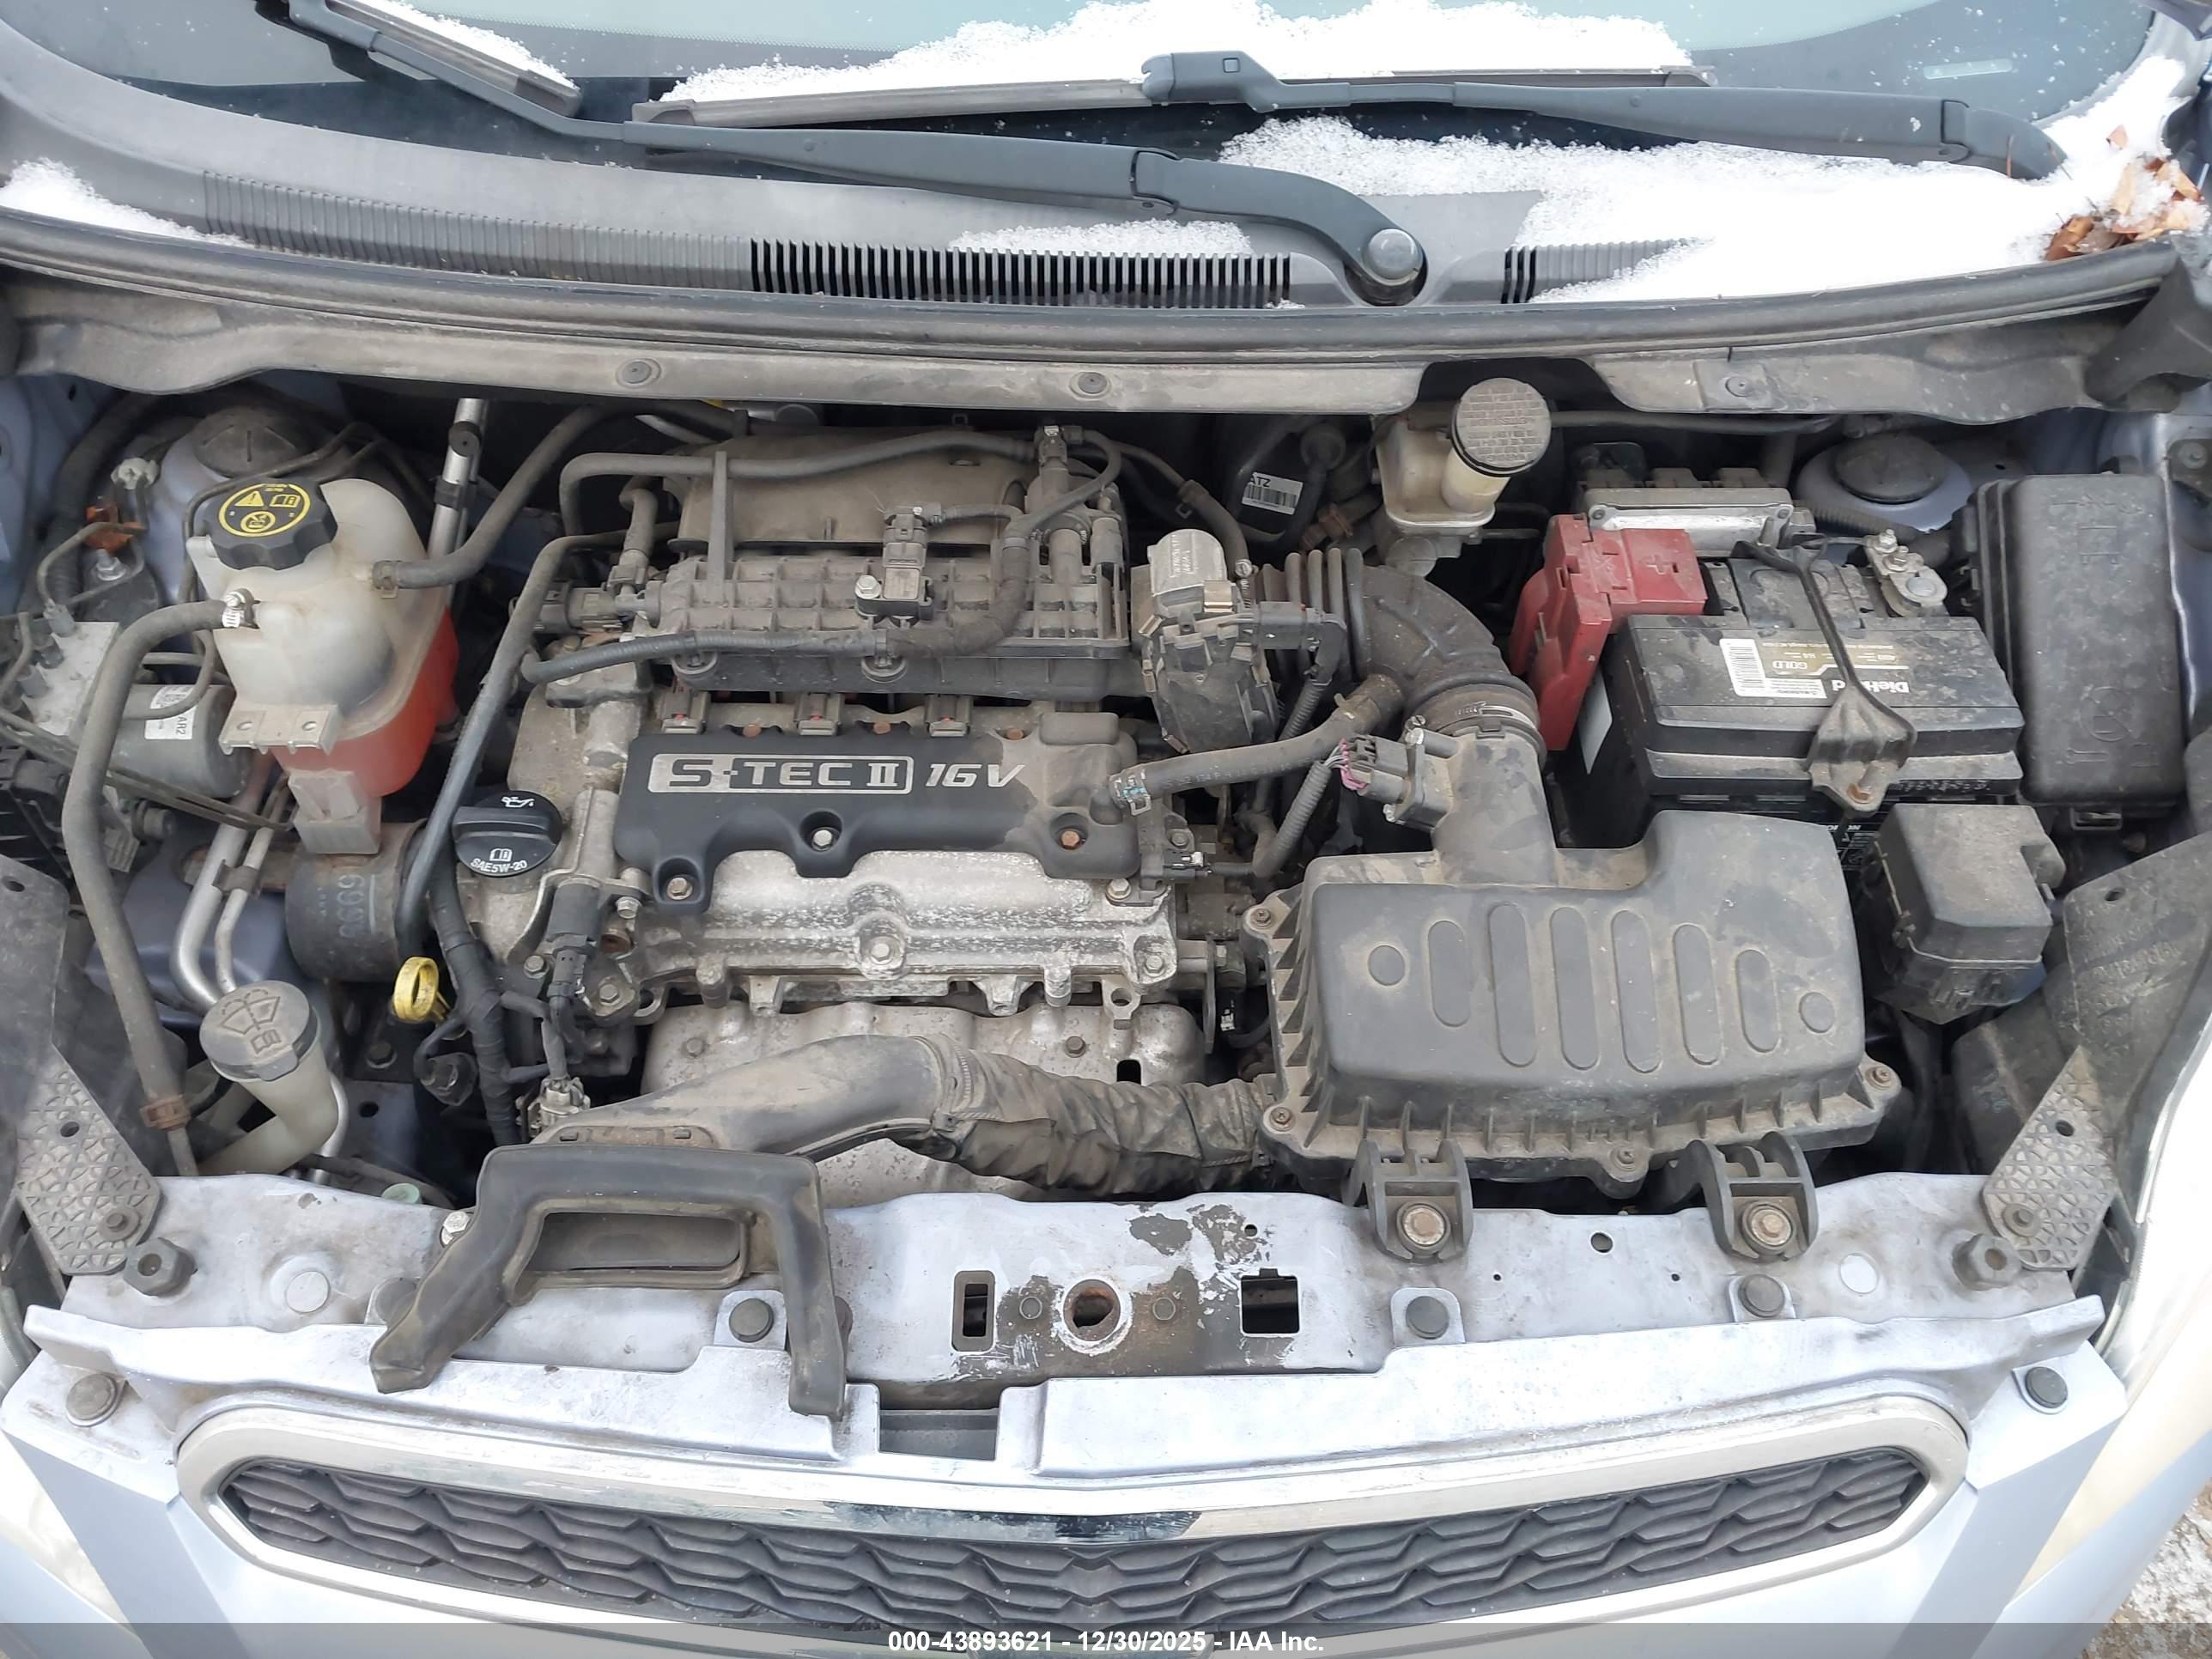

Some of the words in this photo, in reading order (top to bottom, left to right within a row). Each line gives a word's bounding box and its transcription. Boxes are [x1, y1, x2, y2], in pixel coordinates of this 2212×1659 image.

[1772, 660, 1808, 670] GOLD
[1831, 679, 1910, 693] DieHd
[925, 763, 1027, 787] 16V
